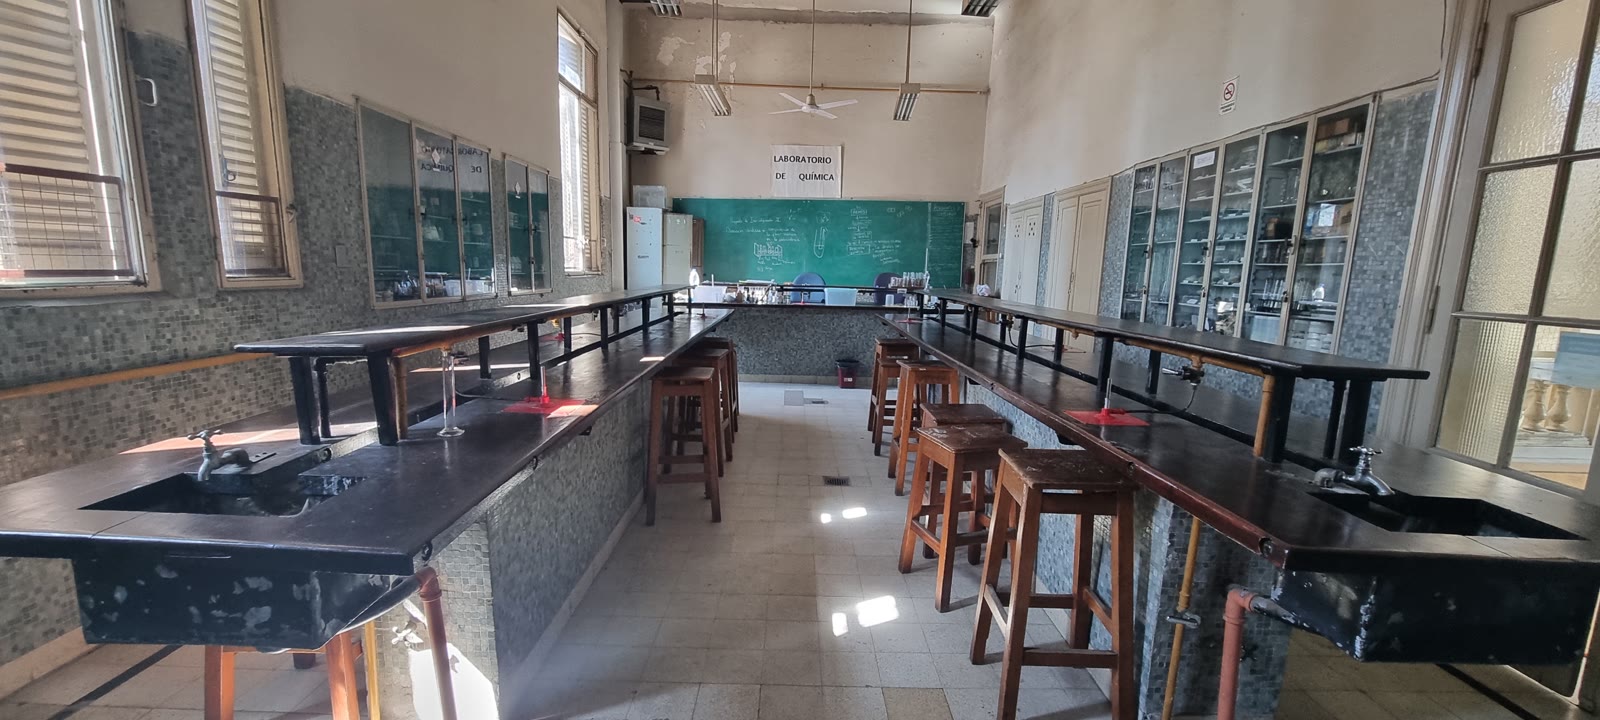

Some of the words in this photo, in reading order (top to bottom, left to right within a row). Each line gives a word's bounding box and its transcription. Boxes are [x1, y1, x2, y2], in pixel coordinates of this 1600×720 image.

[773, 155, 832, 164] LABORATORIO
[775, 172, 787, 180] DE
[798, 171, 835, 182] QUÍMICA
